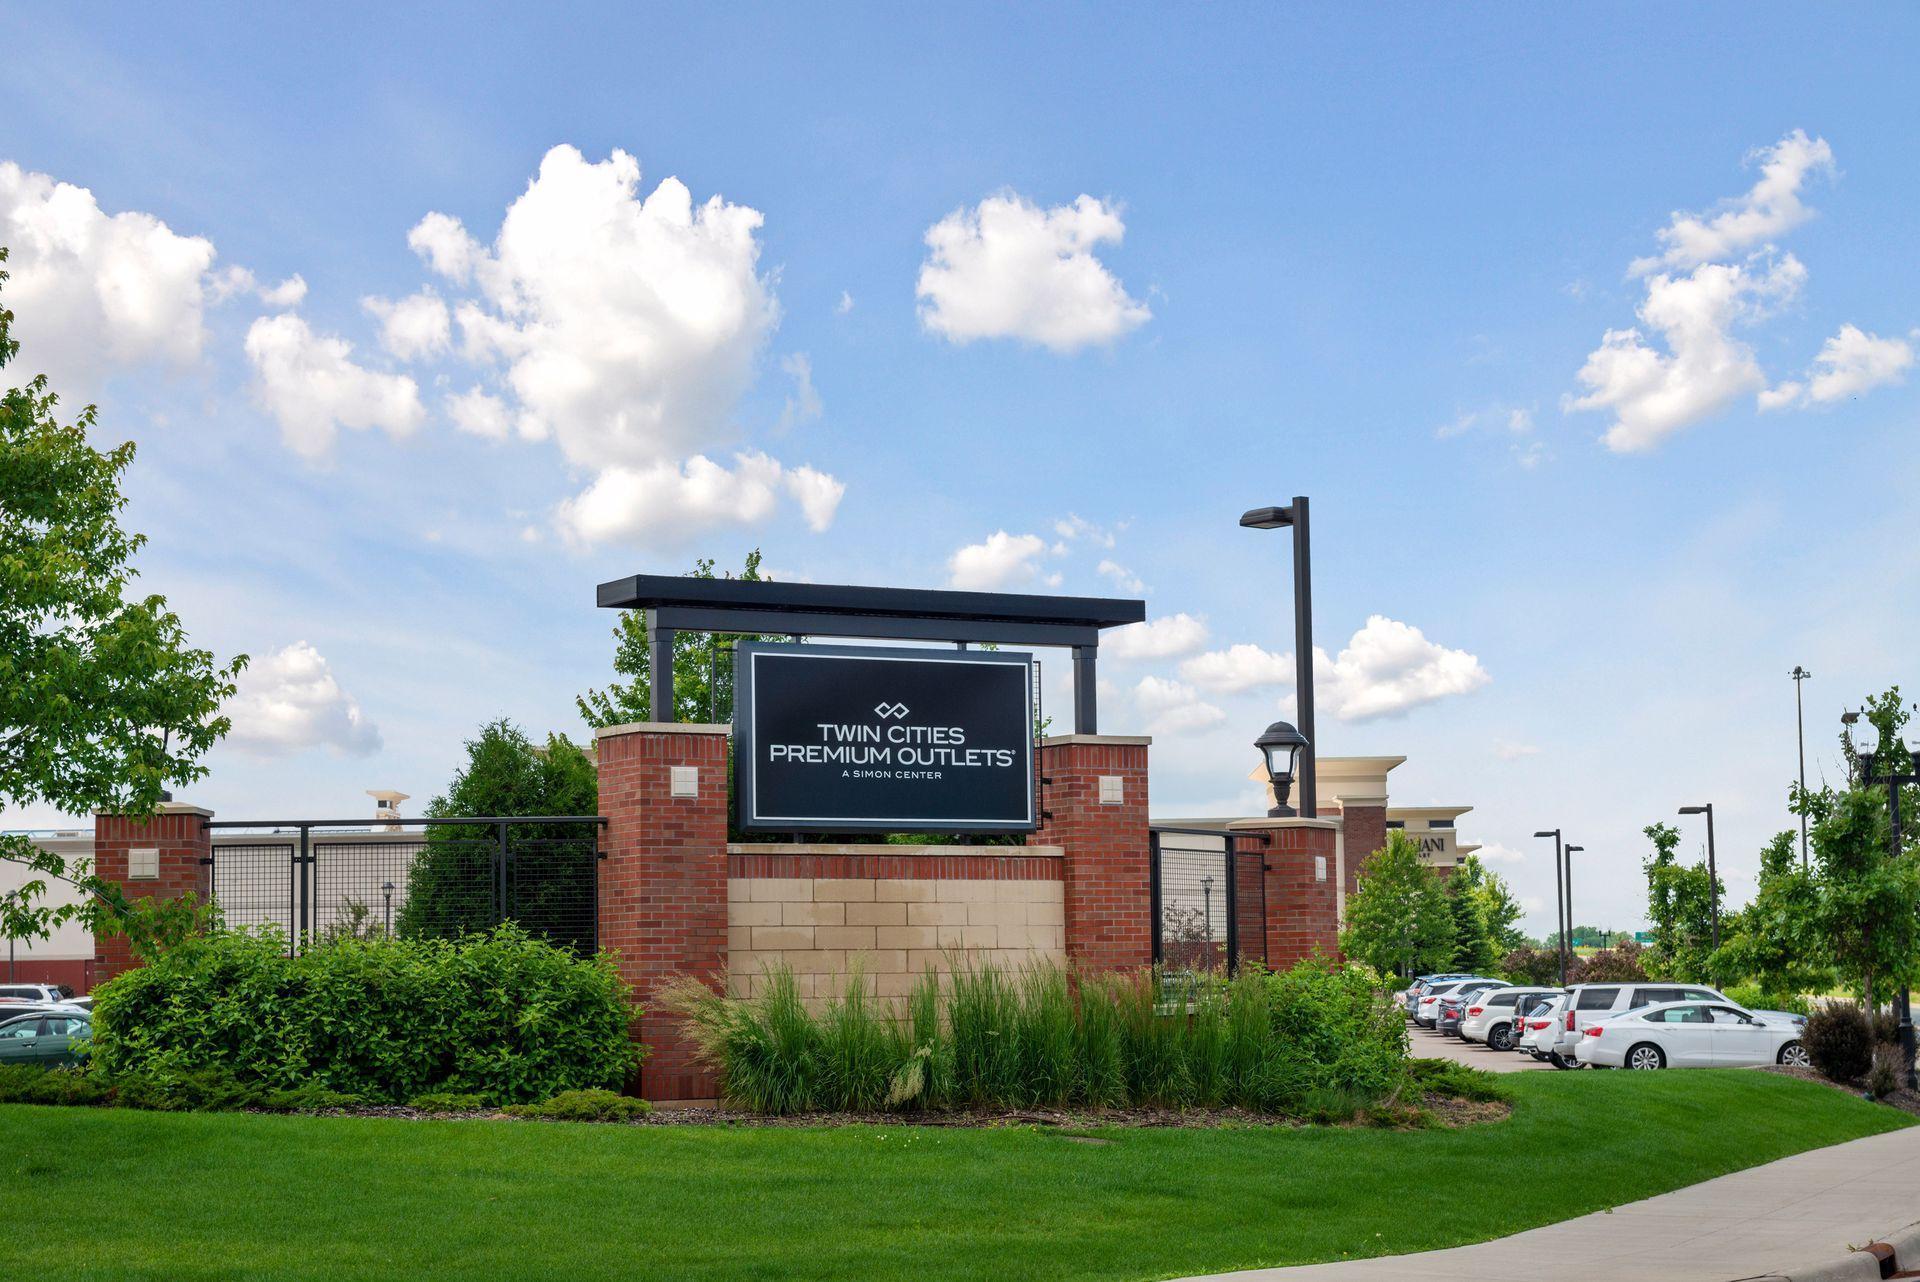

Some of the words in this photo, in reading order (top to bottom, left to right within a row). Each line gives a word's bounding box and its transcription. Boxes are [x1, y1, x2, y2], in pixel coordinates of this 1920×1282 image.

[817, 724, 881, 743] TWIN
[887, 726, 966, 745] CITIES
[769, 744, 891, 765] PREMIUM
[897, 747, 1015, 767] OUTLETS
[841, 770, 850, 778] A
[853, 770, 892, 779] SIMON
[895, 771, 942, 780] CENTER
